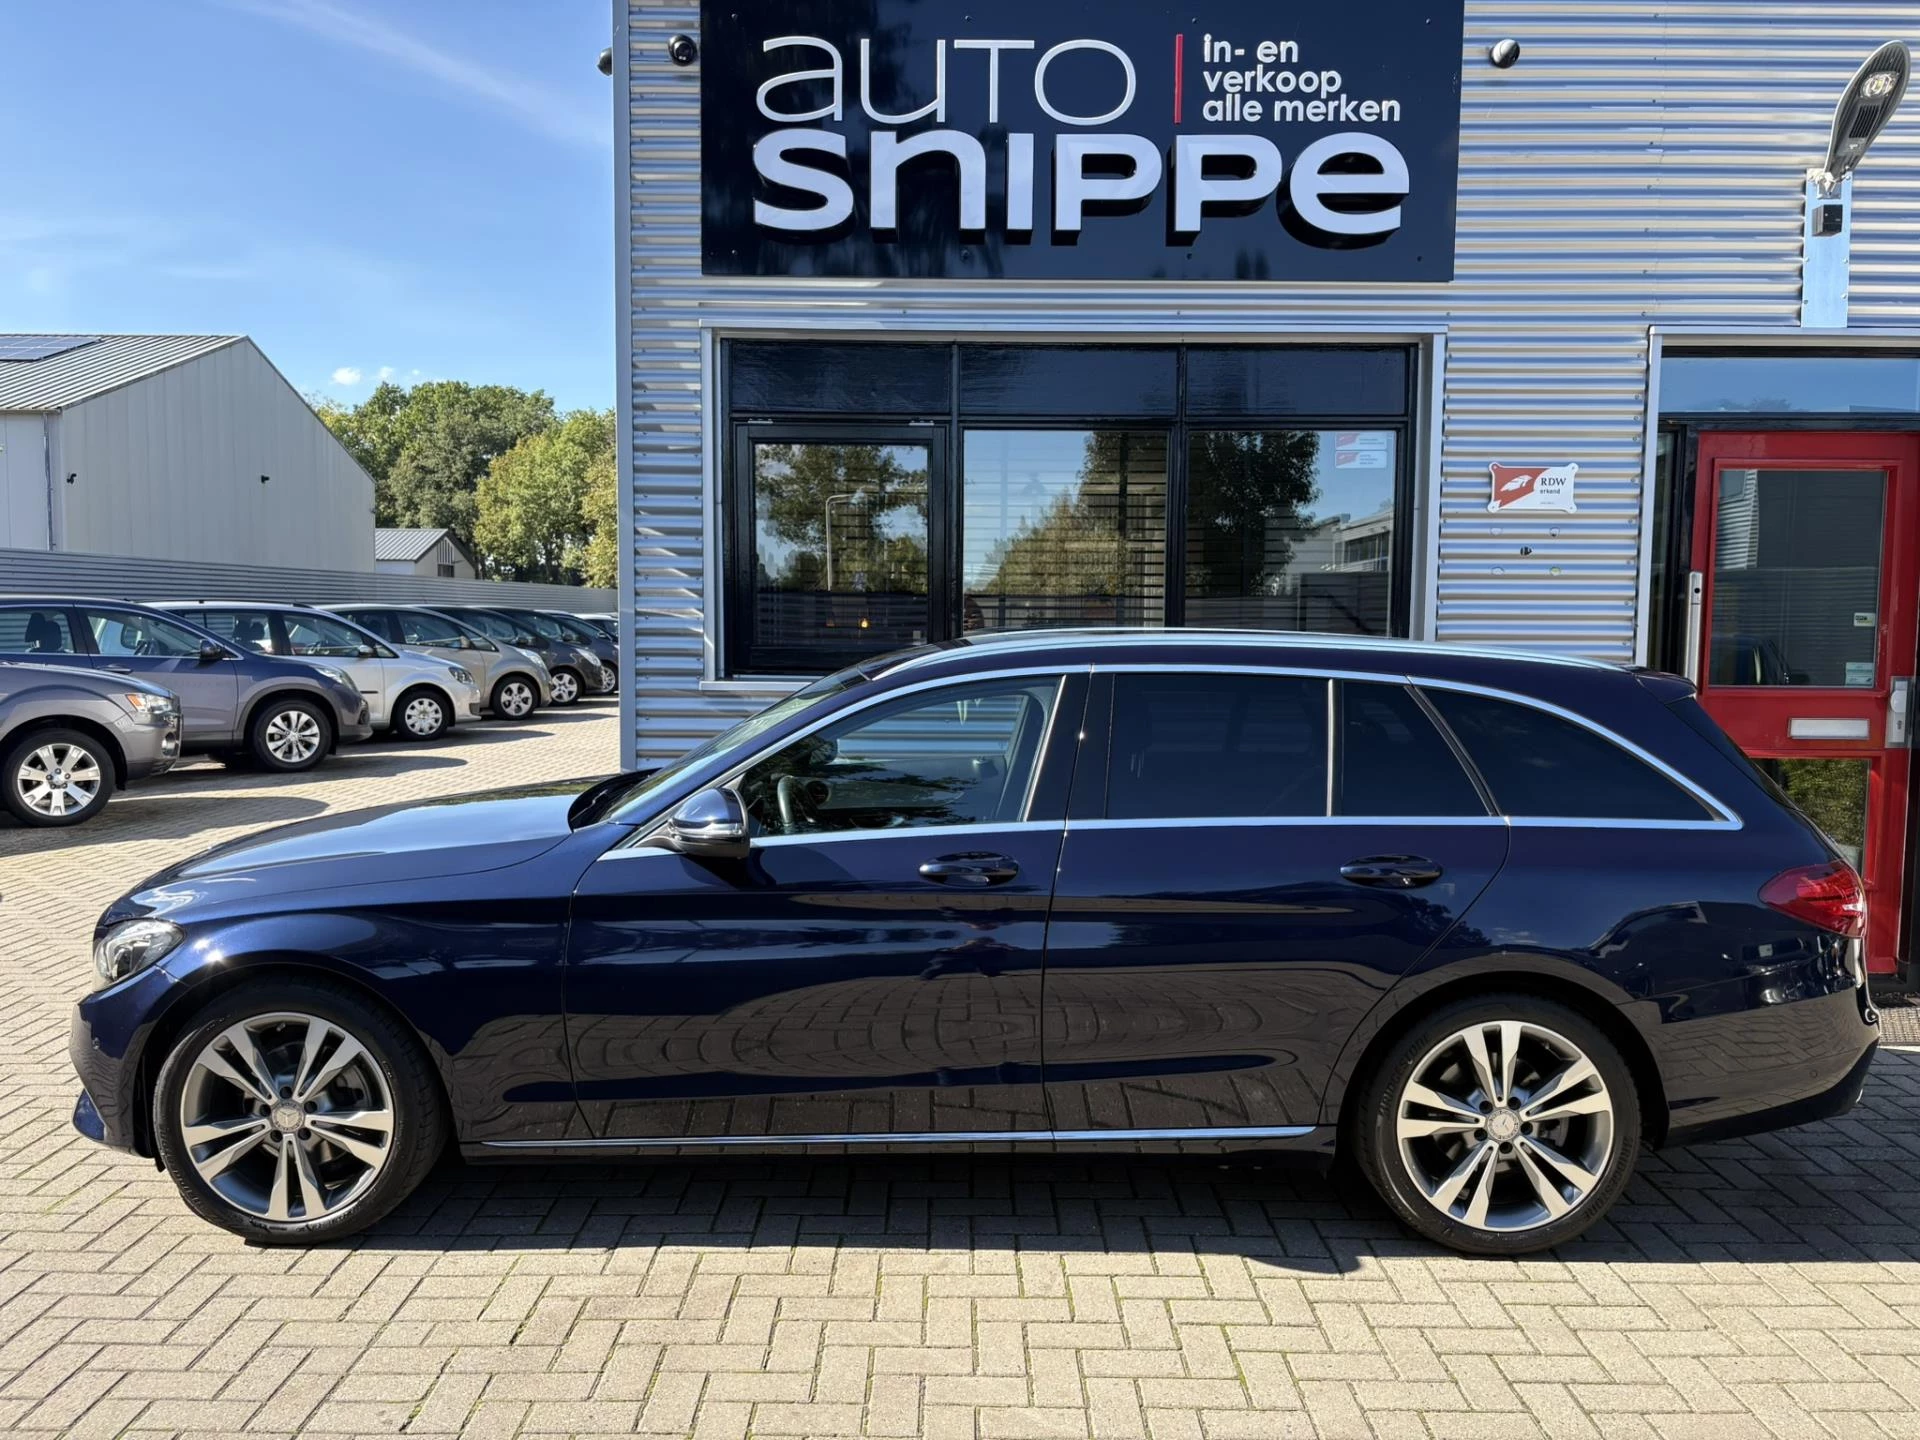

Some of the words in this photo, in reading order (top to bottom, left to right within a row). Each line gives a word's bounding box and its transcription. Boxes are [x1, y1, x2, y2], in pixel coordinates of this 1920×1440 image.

[1203, 33, 1245, 63] in-
[1256, 40, 1299, 63] en
[1202, 63, 1342, 99] verkoop
[1202, 93, 1263, 122] alle
[1273, 93, 1401, 122] merken
[1540, 477, 1567, 486] RDW
